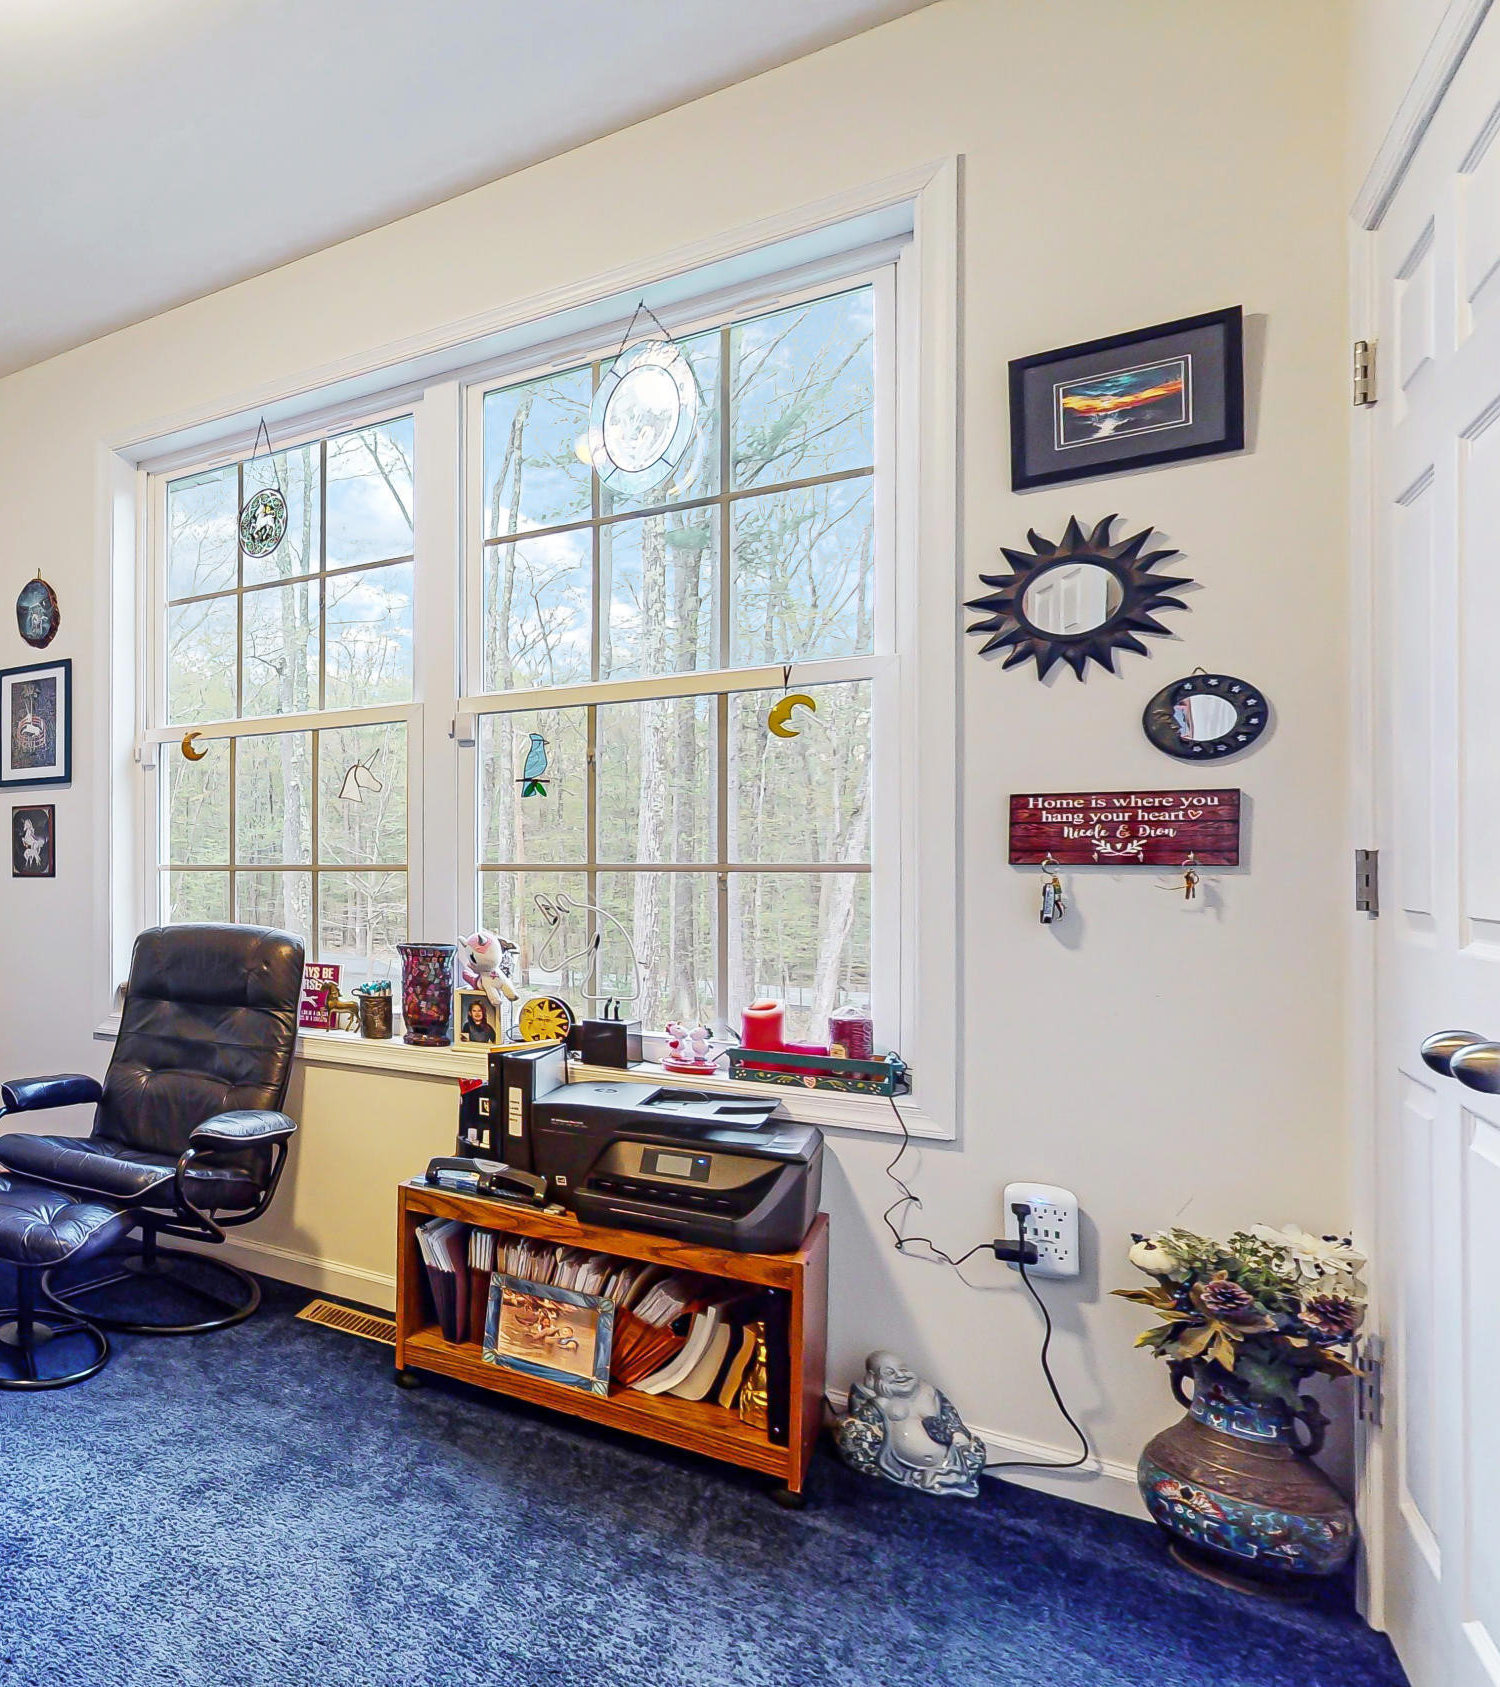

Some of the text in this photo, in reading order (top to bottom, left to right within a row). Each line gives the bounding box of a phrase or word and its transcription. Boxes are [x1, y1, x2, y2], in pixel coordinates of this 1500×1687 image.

[1026, 795, 1219, 809] Home is where you
[1041, 809, 1185, 824] hang your heart
[1063, 824, 1177, 839] Nicole & Dion
[322, 967, 335, 980] BE
